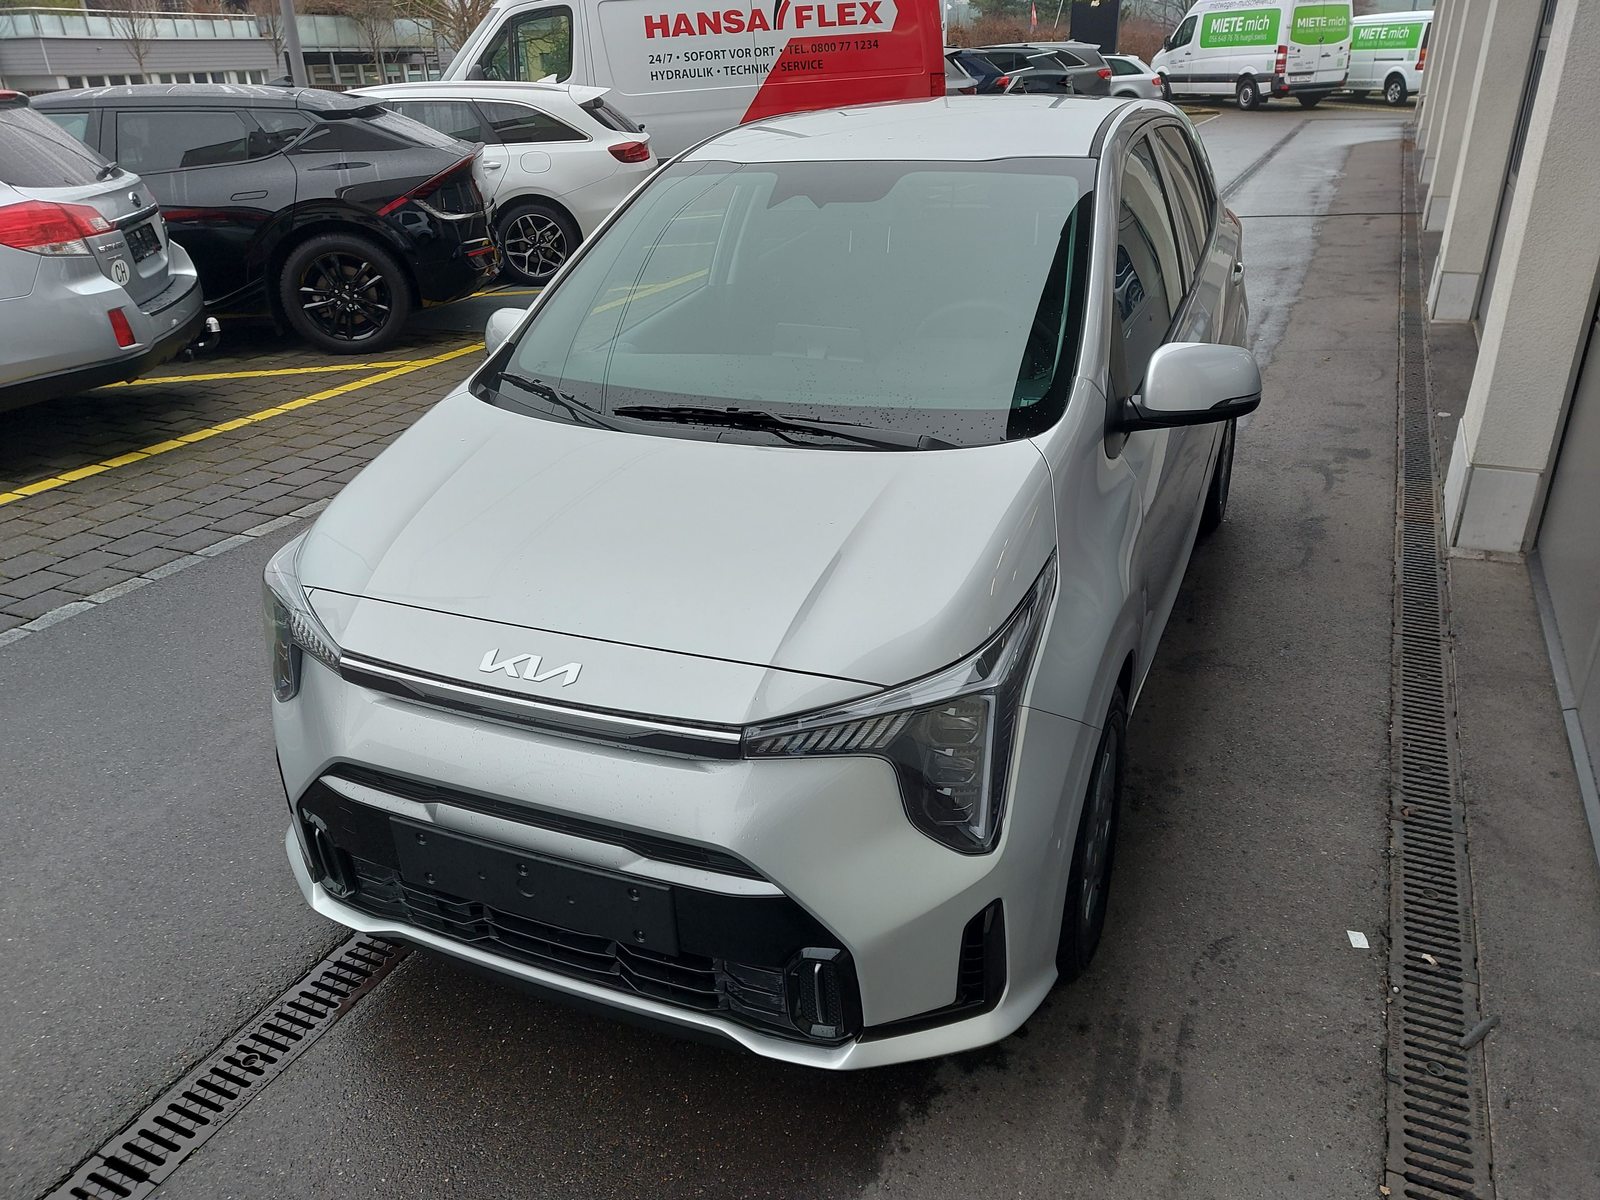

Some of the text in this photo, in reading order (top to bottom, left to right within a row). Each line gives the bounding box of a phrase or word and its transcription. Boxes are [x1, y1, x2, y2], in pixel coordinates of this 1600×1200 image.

[644, 1, 883, 39] HANSA FLEX
[1210, 14, 1270, 34] MIETE mich
[1297, 16, 1347, 28] MIETE mich
[1358, 27, 1389, 40] MIETE
[1387, 26, 1410, 39] mich
[648, 39, 879, 65] 24/7 SOFORT VOR ORT TEL. 0800 77 1234
[650, 59, 823, 81] HYDRAULIK TECHNIK SERVICE
[115, 262, 128, 283] CH
[479, 648, 583, 687] KIA
